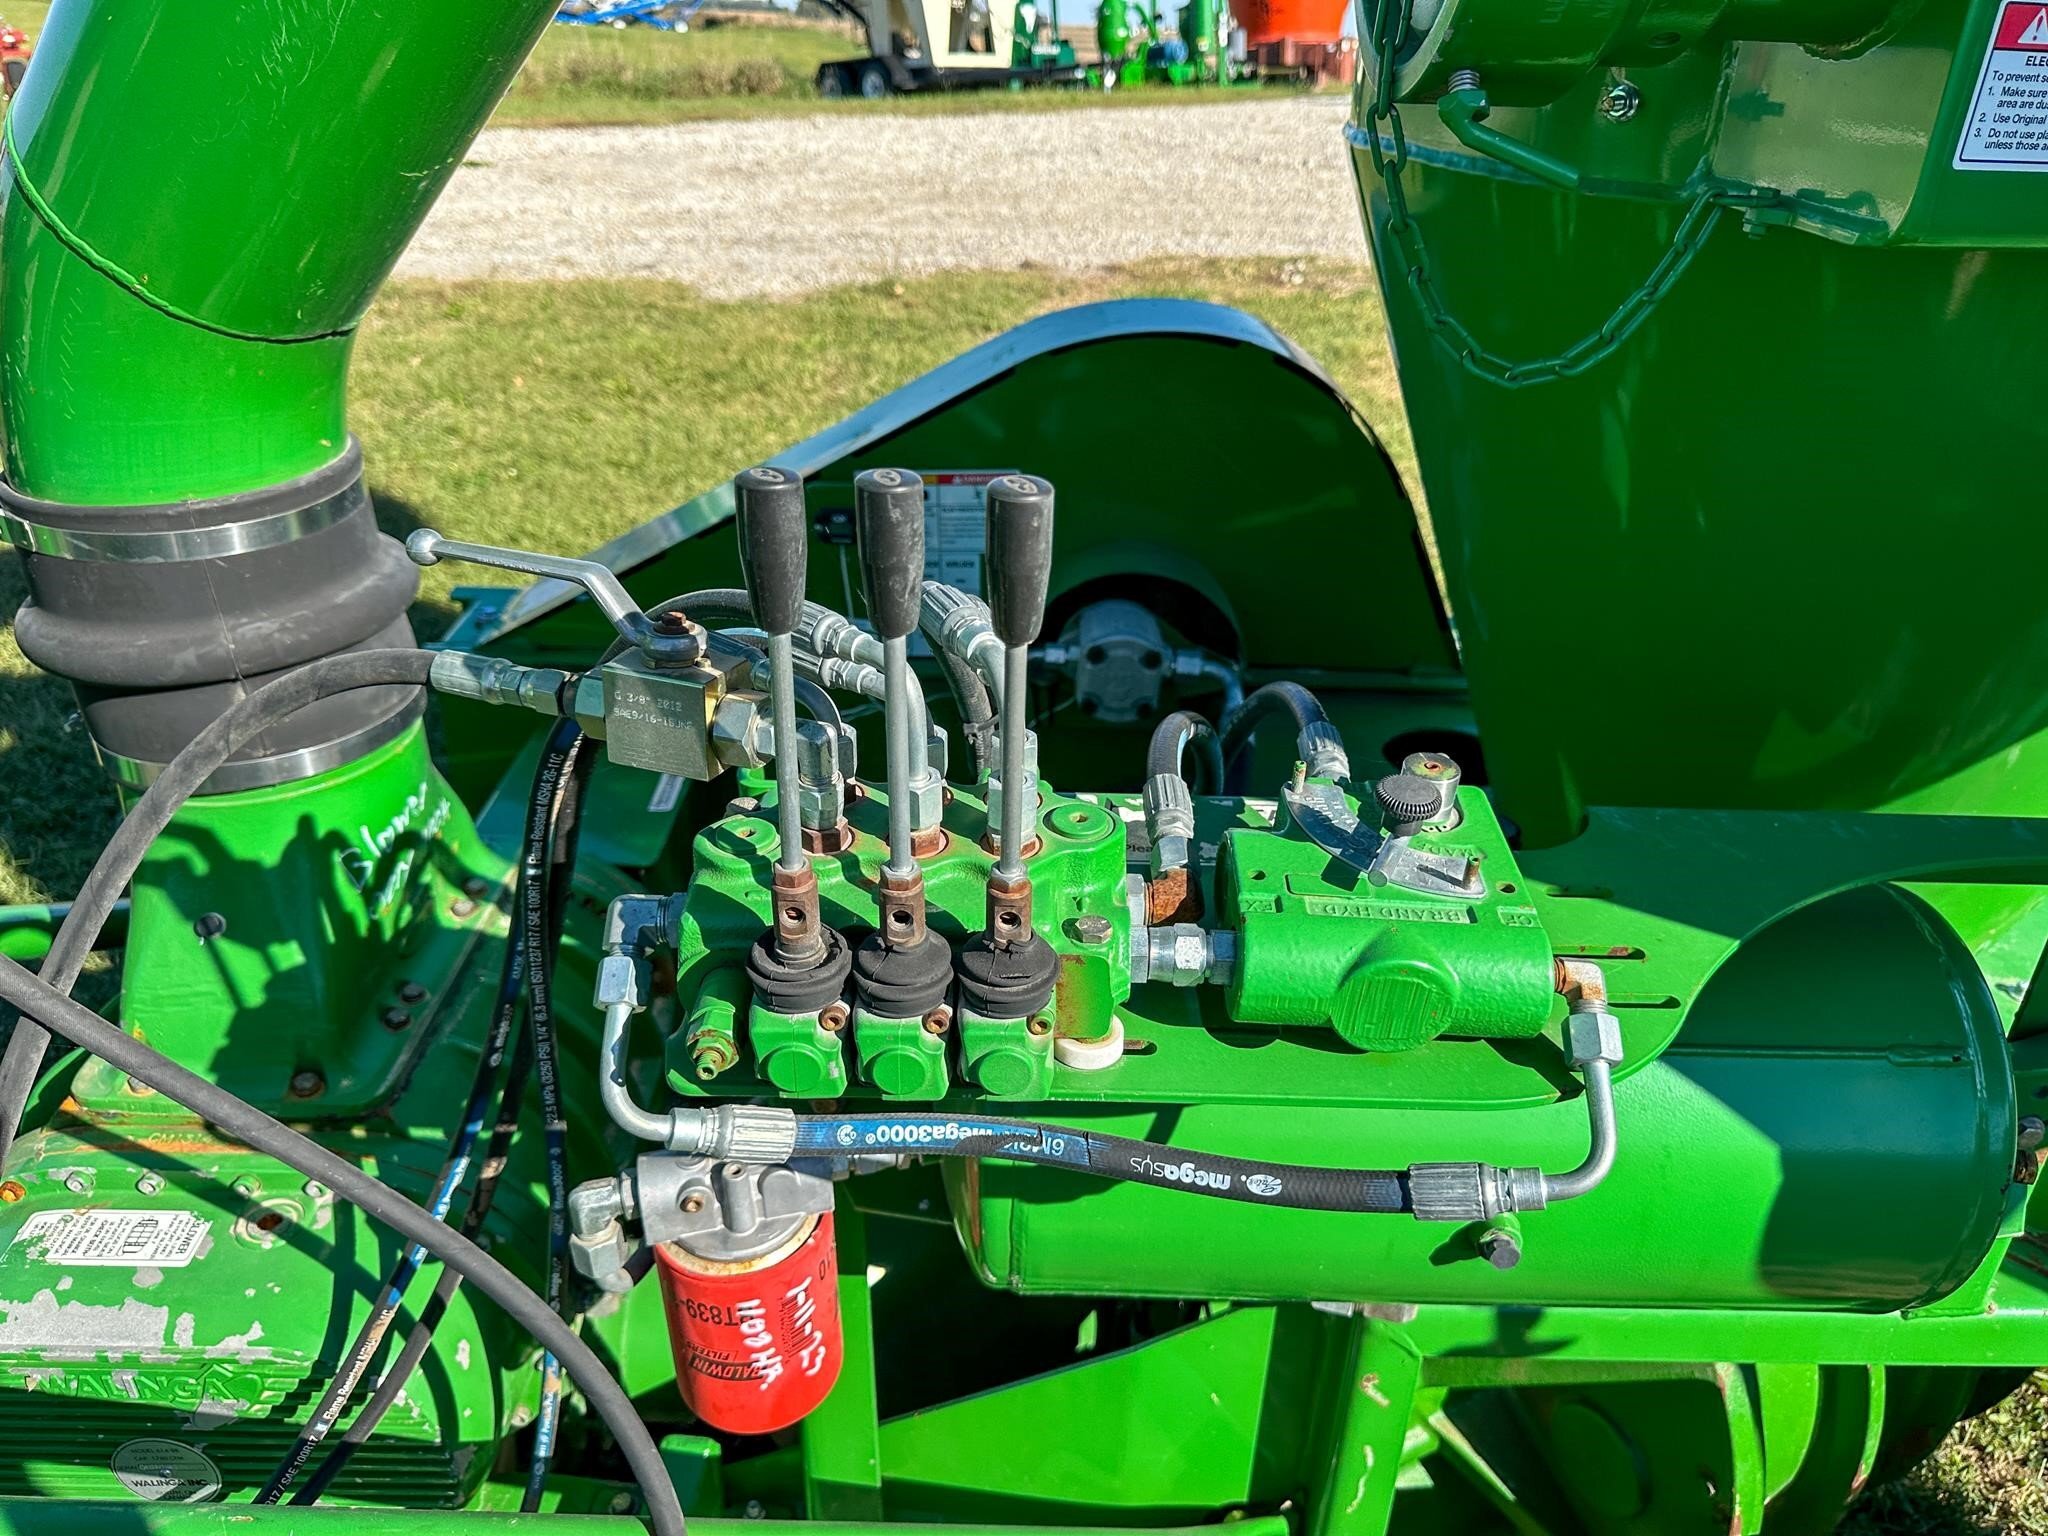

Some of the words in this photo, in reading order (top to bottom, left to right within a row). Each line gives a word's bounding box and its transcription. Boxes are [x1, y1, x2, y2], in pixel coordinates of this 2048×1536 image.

[1993, 70, 2004, 81] To
[2005, 73, 2040, 83] prevent
[1988, 86, 1995, 96] 1.
[2000, 86, 2026, 97] Make
[2027, 89, 2048, 98] sure
[1997, 100, 2018, 108] area
[2019, 101, 2034, 109] are
[1978, 112, 1986, 122] 2.
[1993, 113, 2010, 123] Use
[2012, 113, 2047, 126] Original
[1974, 127, 1982, 138] 3.
[1988, 128, 2001, 138] Do
[2002, 129, 2018, 139] not
[2020, 131, 2036, 139] use
[1984, 140, 2013, 150] unless
[2015, 140, 2040, 151] those
[535, 781, 551, 808] MSHA
[530, 804, 547, 843] Resistant
[528, 839, 543, 865] Flame
[527, 880, 541, 911] 100R17
[528, 908, 541, 927] SAE
[1381, 906, 1461, 922] BRAND
[529, 931, 541, 949] R17
[543, 1083, 556, 1105] MPa
[1130, 1154, 1232, 1190] megasys
[692, 1357, 762, 1381] BALDWIN
[25, 1373, 239, 1405] WALINGA
[281, 1464, 299, 1485] SAE
[294, 1434, 319, 1470] 100R17
[323, 1394, 342, 1420] Flame
[131, 1478, 184, 1487] WALINGA
